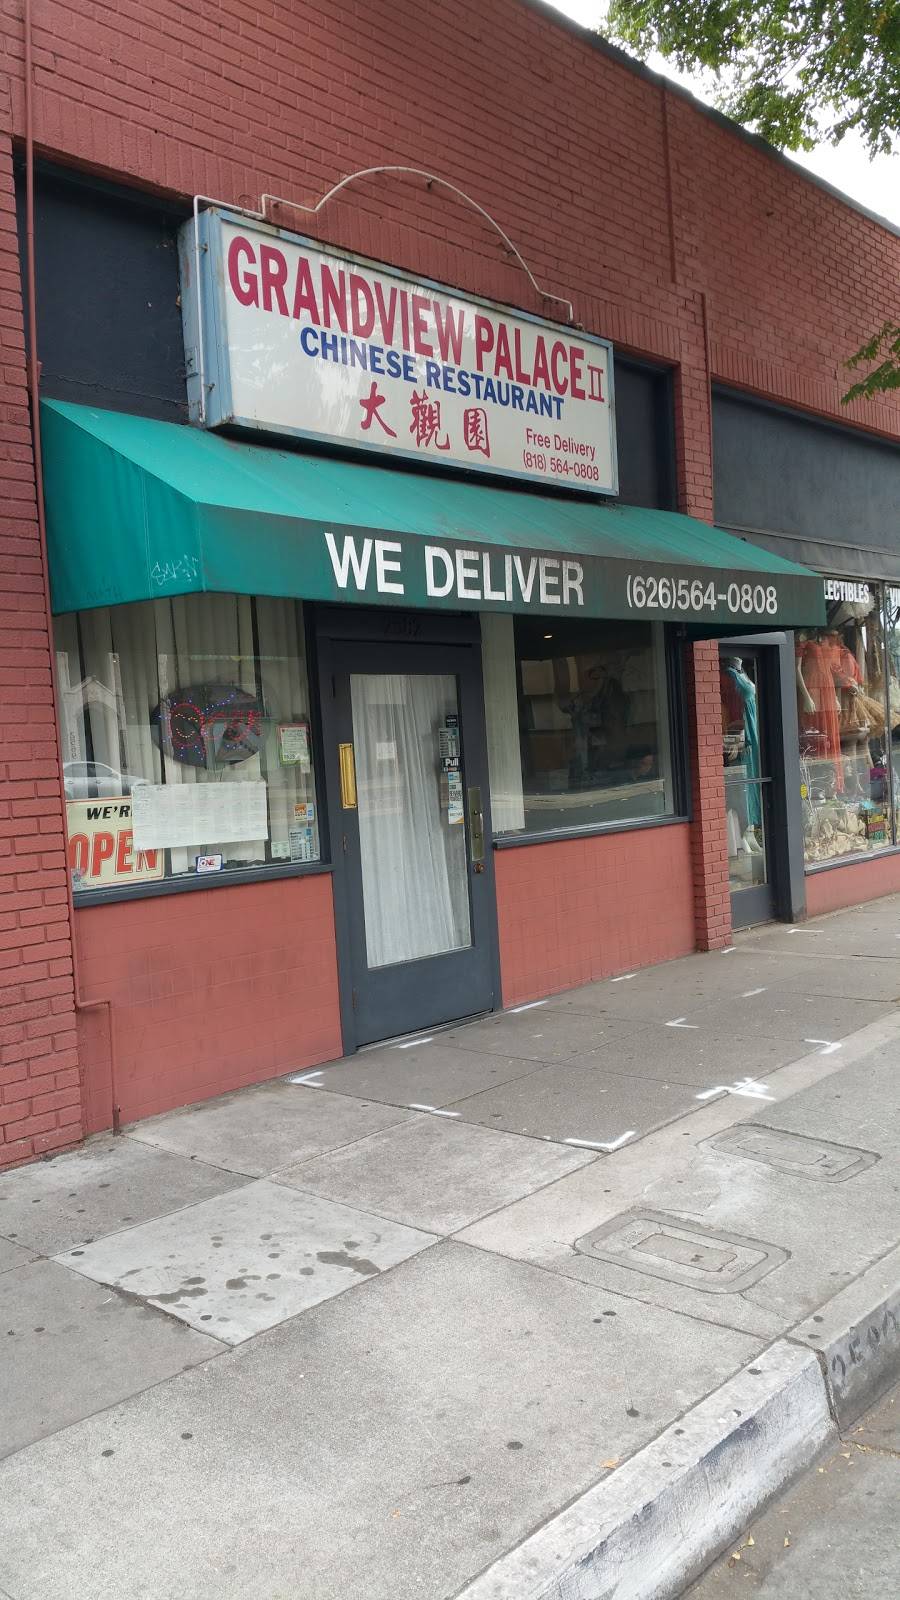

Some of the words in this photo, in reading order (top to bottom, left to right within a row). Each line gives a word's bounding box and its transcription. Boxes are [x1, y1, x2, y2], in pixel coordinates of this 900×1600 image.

[228, 236, 465, 366] GRANDVIEW
[475, 314, 586, 401] PALACE
[301, 326, 418, 384] CHINESE
[426, 359, 565, 421] RESTAURANT
[525, 427, 551, 449] Free
[554, 434, 596, 461] Delivery
[522, 448, 547, 471] (818)
[549, 454, 600, 482] 564-0808
[324, 532, 405, 595] WE
[425, 545, 585, 606] DELIVER
[625, 573, 778, 615] (626)564-0808
[445, 757, 459, 767] Pull
[86, 804, 133, 821] WE'R
